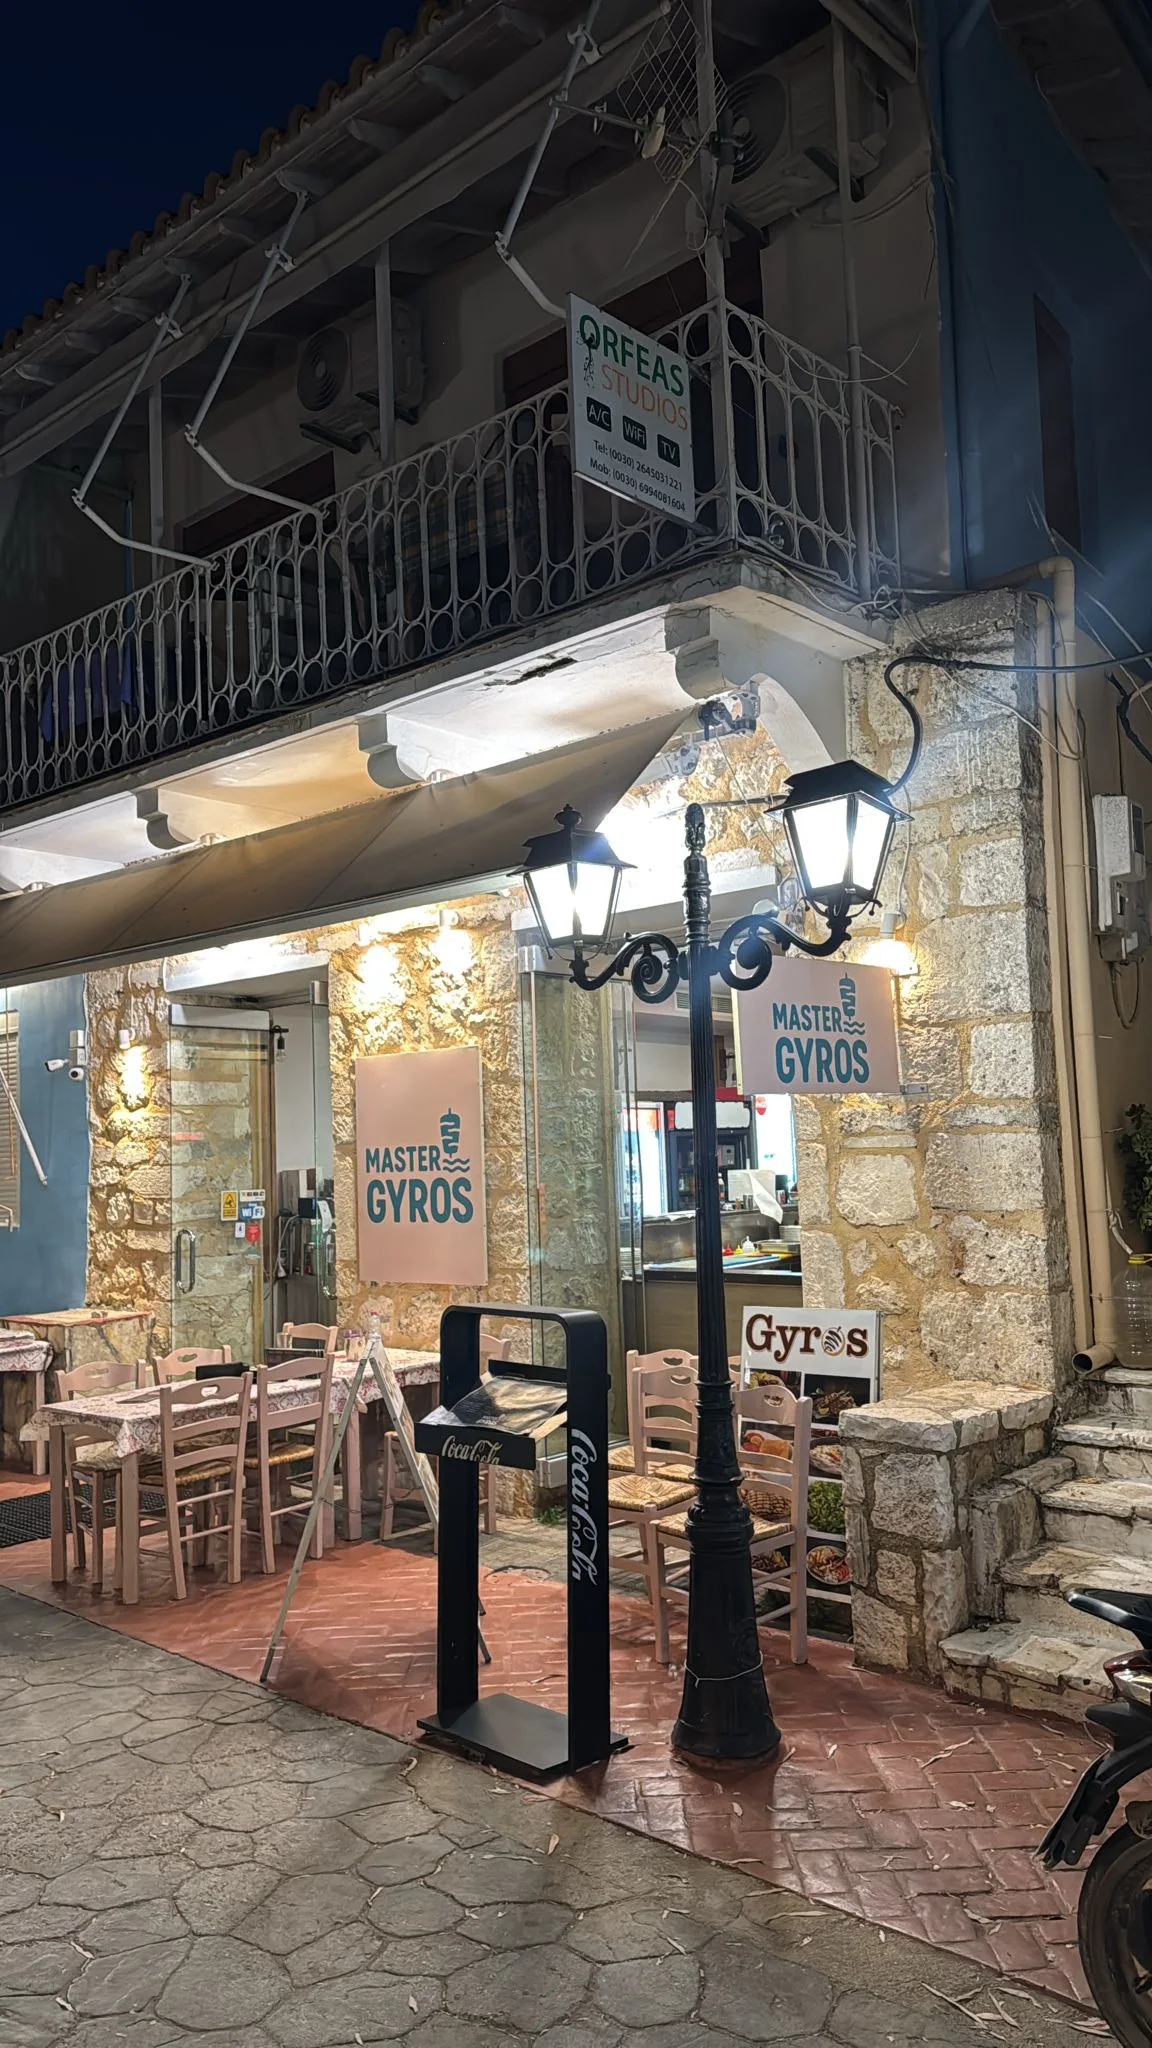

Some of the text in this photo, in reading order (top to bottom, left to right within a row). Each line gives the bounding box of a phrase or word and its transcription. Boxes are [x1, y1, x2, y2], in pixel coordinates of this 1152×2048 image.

[579, 314, 684, 397] ORFEAS
[602, 364, 687, 430] STUDIOS
[589, 404, 676, 459] A/C WiFi TV
[590, 457, 685, 512] Mob: (0030) 6994081604
[594, 440, 682, 491] Tel: (0030) 2645031221
[772, 1003, 843, 1032] MASTER
[775, 1036, 870, 1083] GYROS
[365, 1145, 441, 1173] MASTER
[367, 1177, 474, 1223] GYROS
[746, 1313, 869, 1363] Gyros
